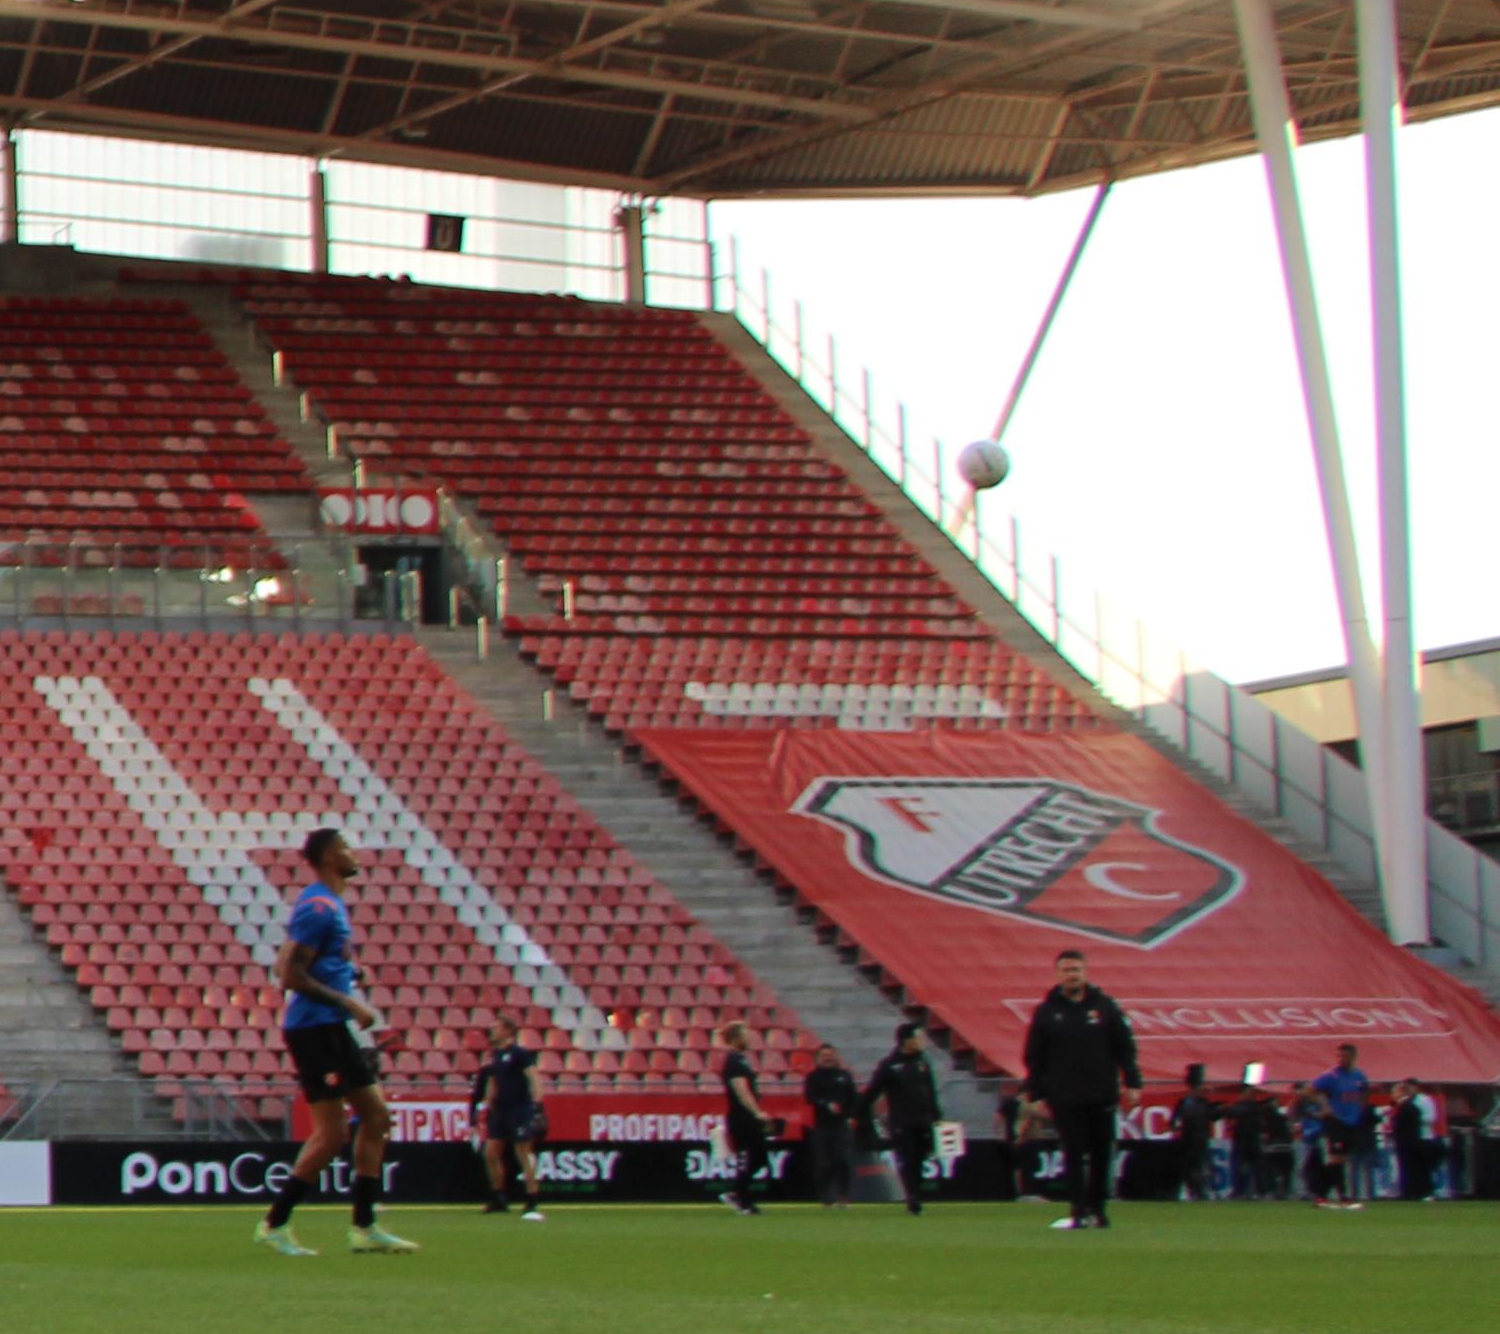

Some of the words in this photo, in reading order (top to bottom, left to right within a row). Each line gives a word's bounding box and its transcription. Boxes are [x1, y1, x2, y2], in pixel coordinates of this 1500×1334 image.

[875, 795, 942, 834] F
[939, 791, 1118, 905] UTRECHT
[1083, 861, 1181, 901] C
[1123, 1007, 1422, 1029] NCLUSION
[590, 1114, 728, 1140] PROFIPAC
[121, 1152, 399, 1194] PonCetr
